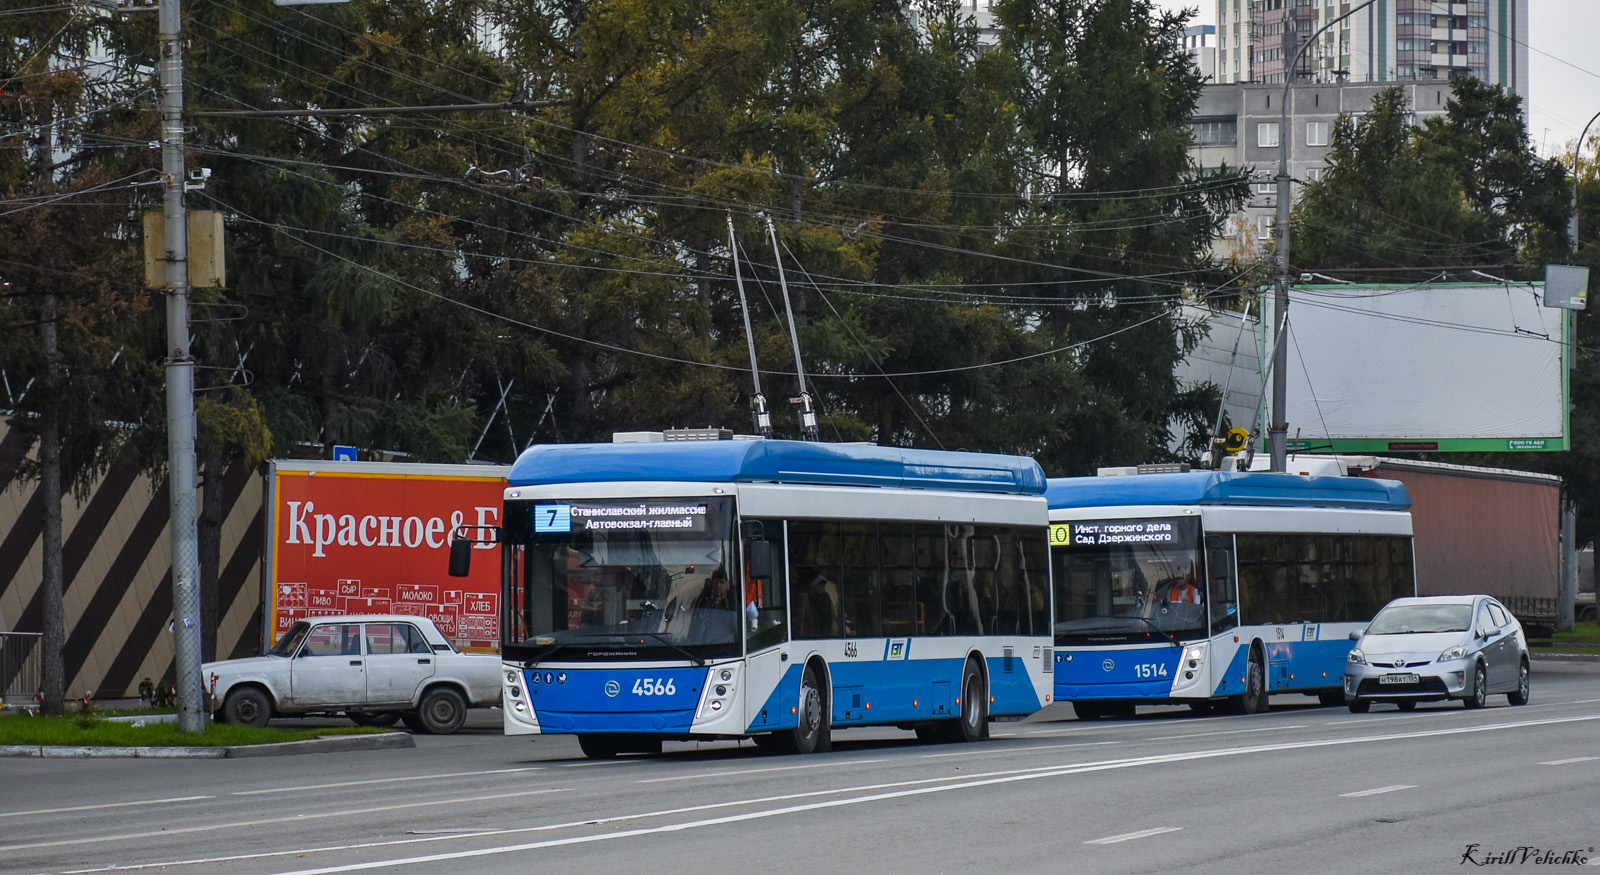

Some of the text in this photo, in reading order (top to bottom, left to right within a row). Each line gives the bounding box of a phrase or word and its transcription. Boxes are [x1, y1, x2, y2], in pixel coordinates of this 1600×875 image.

[571, 505, 706, 516] Станиславский жилмассив
[546, 510, 557, 526] 7
[585, 517, 693, 529] Автовокзал-главный
[1075, 523, 1172, 534] Инст. горного дела
[1075, 534, 1172, 544] Сад Дзержинского
[341, 585, 357, 594] СЫР
[312, 596, 331, 605] ПИВО
[402, 591, 433, 601] МОЛОКО
[470, 601, 491, 611] ХЛЕБ
[844, 642, 857, 658] 4566
[1134, 663, 1168, 678] 1514
[632, 678, 676, 696] 4566
